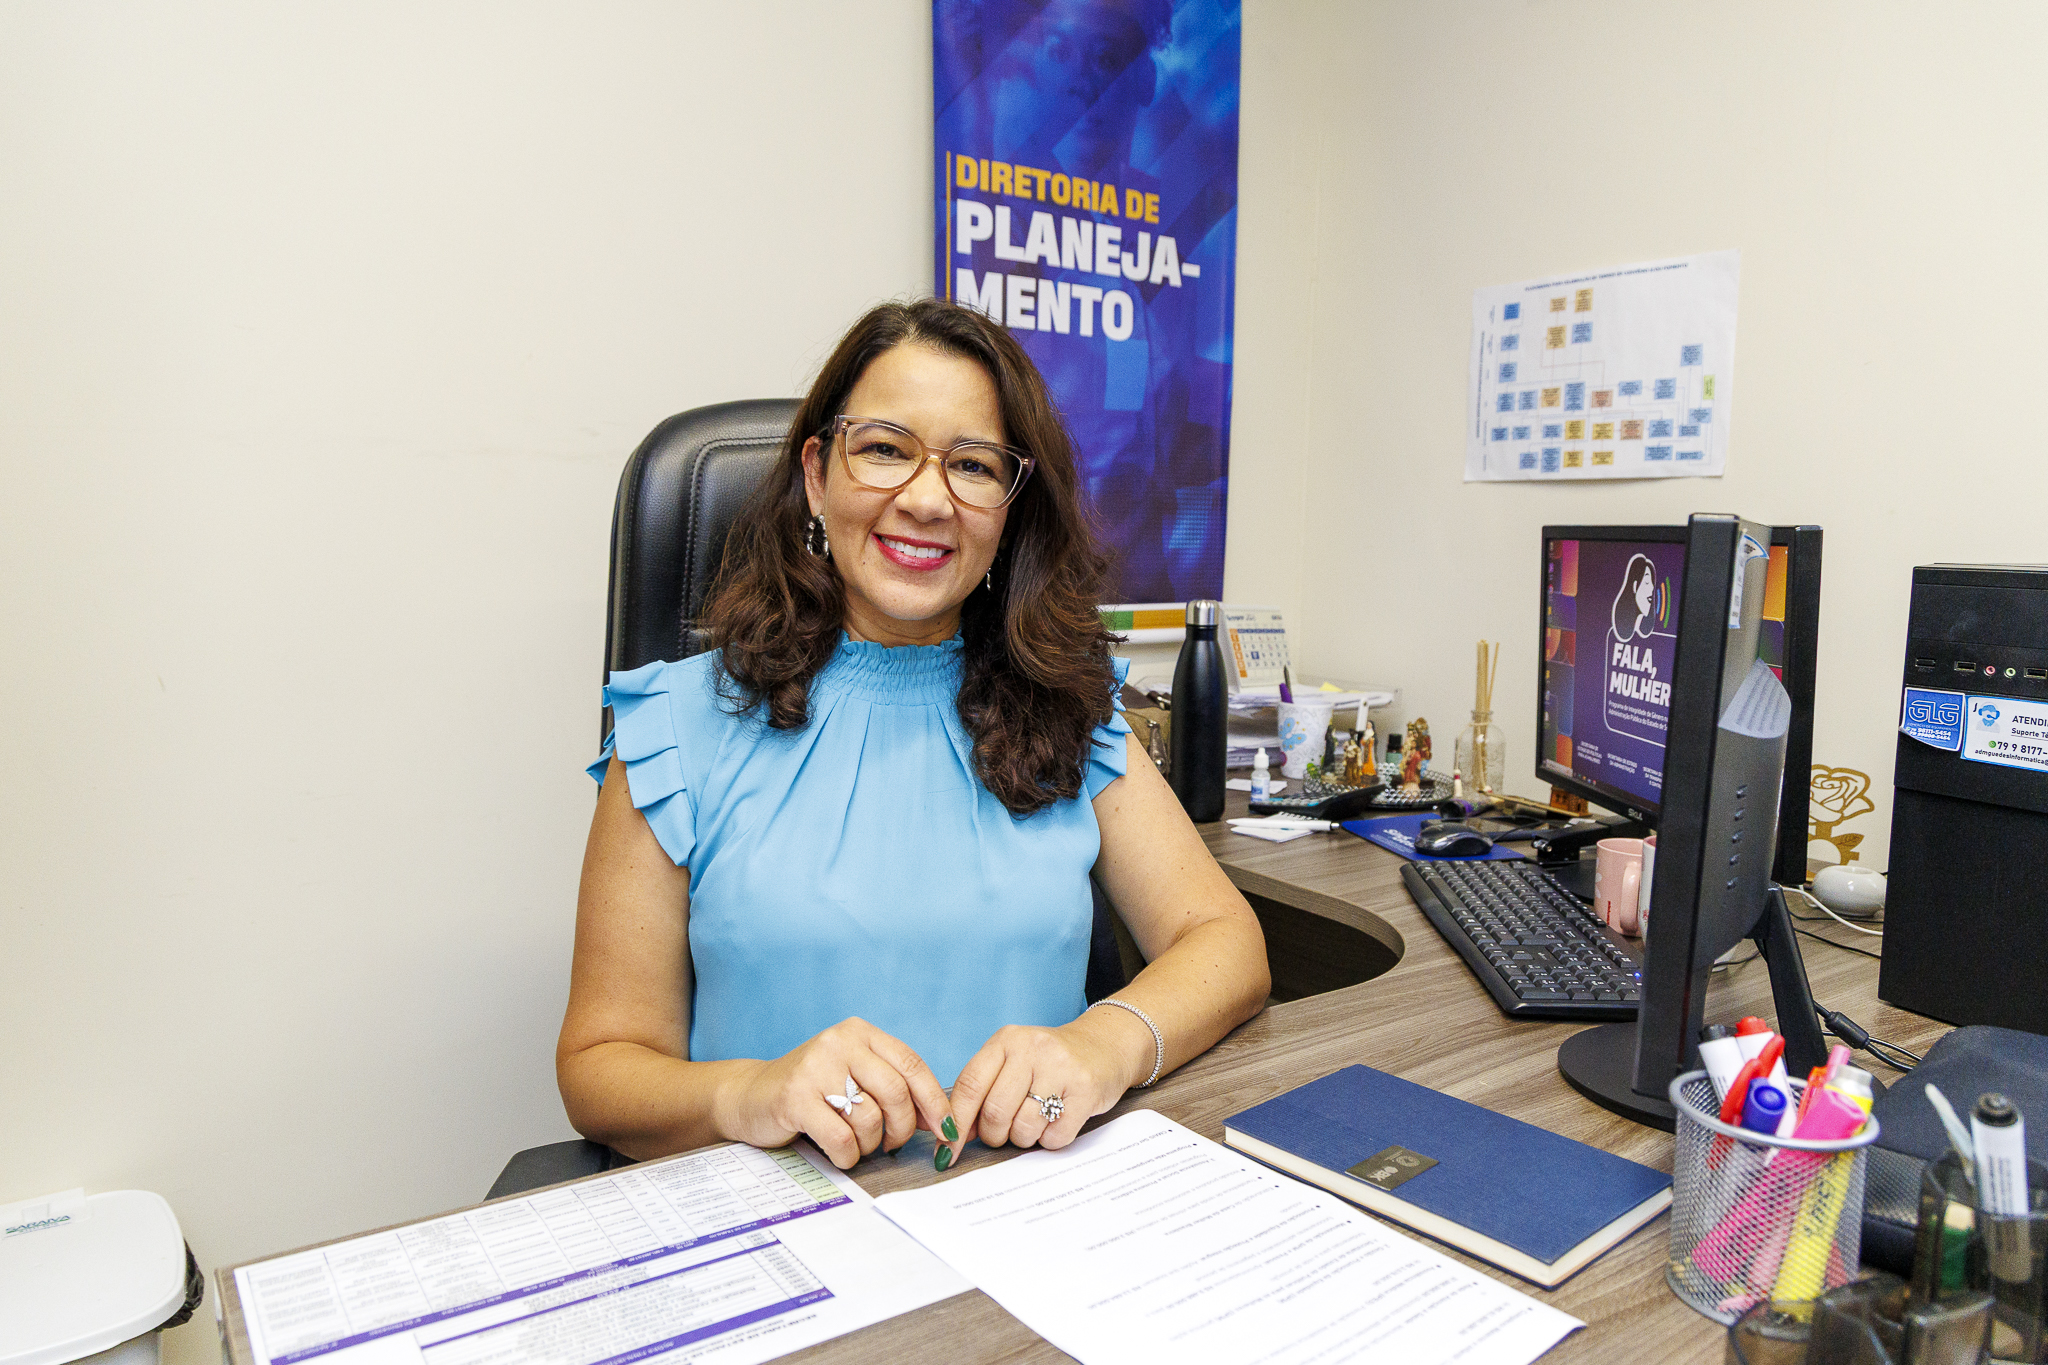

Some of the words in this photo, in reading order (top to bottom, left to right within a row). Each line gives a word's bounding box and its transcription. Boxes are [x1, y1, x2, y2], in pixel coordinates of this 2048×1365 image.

[956, 154, 1119, 216] DIRETORIA
[1125, 188, 1160, 224] DE
[956, 198, 1201, 287] PLANEJA-
[956, 268, 1134, 342] MENTO
[1612, 642, 1657, 680] FALA,
[1609, 671, 1671, 707] MULHER
[2012, 715, 2048, 727] ATENDI
[2012, 728, 2039, 737] Suporte
[1998, 741, 2008, 750] 79
